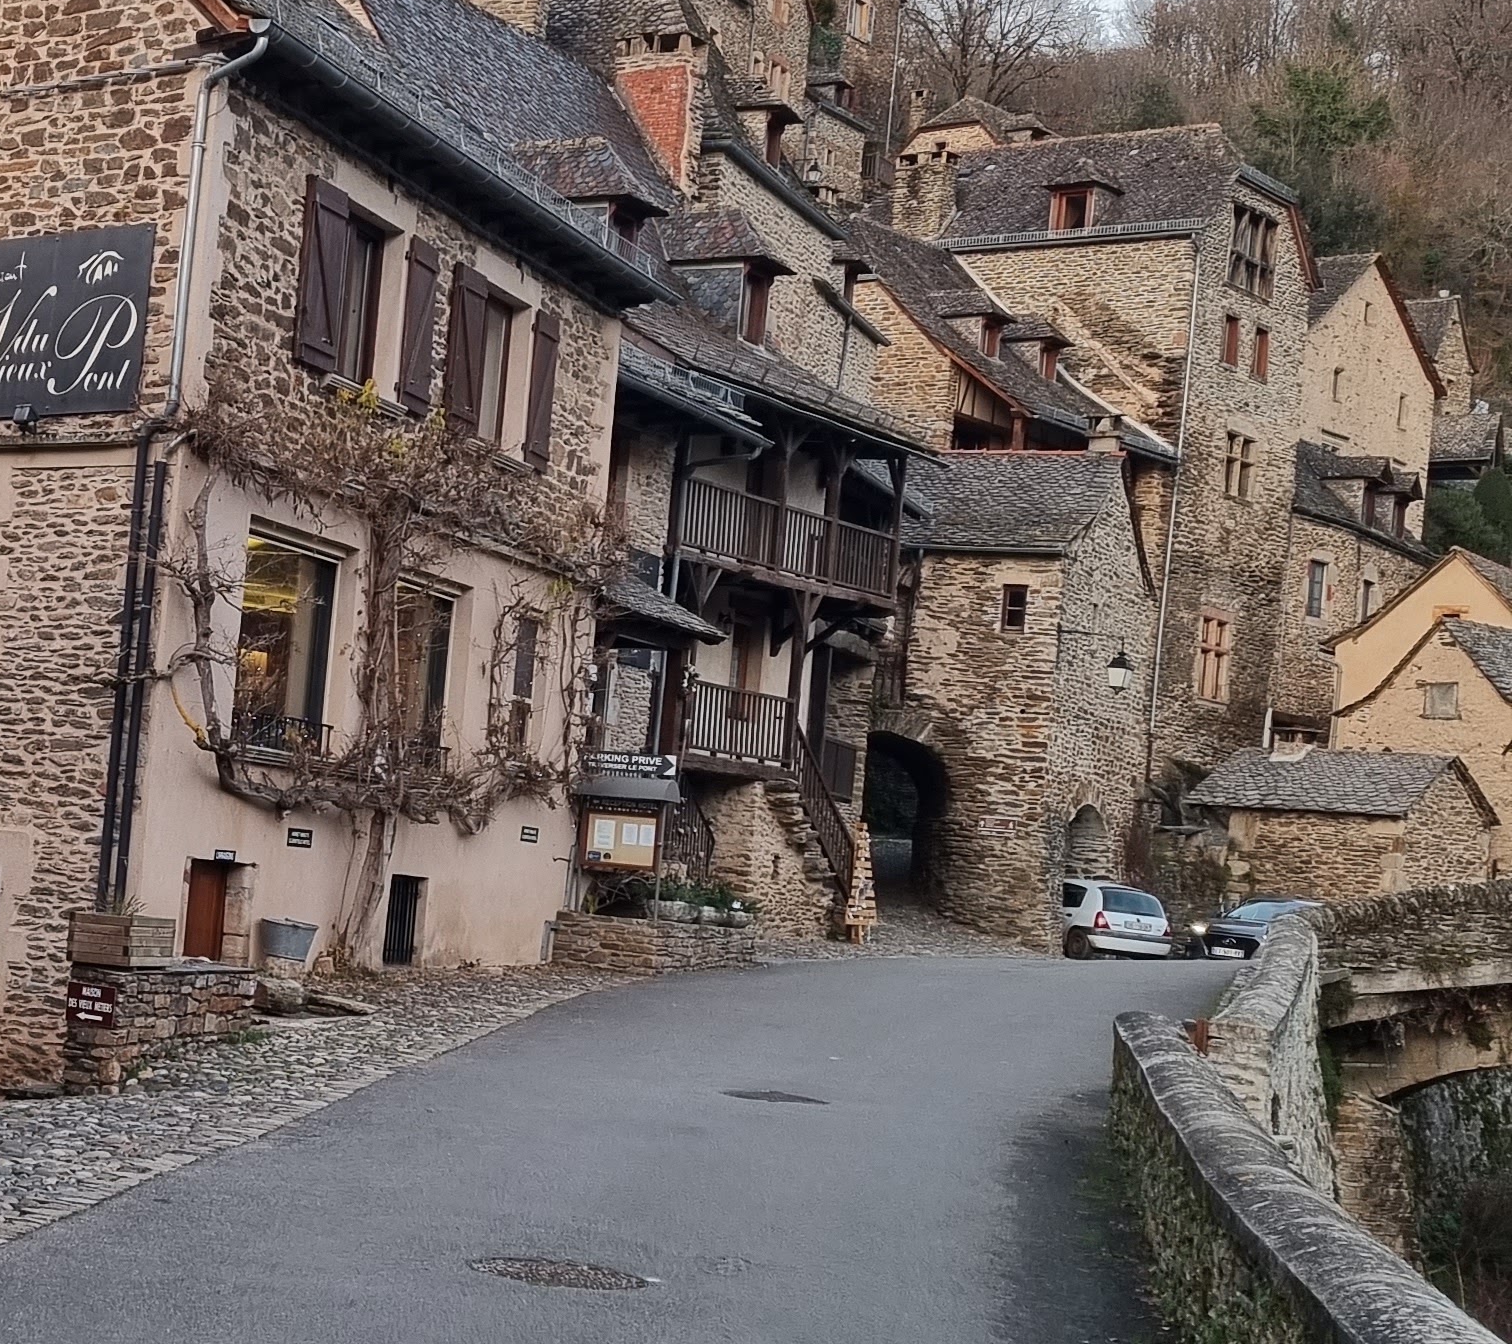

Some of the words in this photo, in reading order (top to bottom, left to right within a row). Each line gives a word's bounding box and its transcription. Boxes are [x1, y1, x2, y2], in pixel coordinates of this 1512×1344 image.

[13, 318, 49, 353] du
[47, 293, 138, 395] Pont
[68, 997, 78, 1008] DES
[82, 986, 101, 998] MAISON
